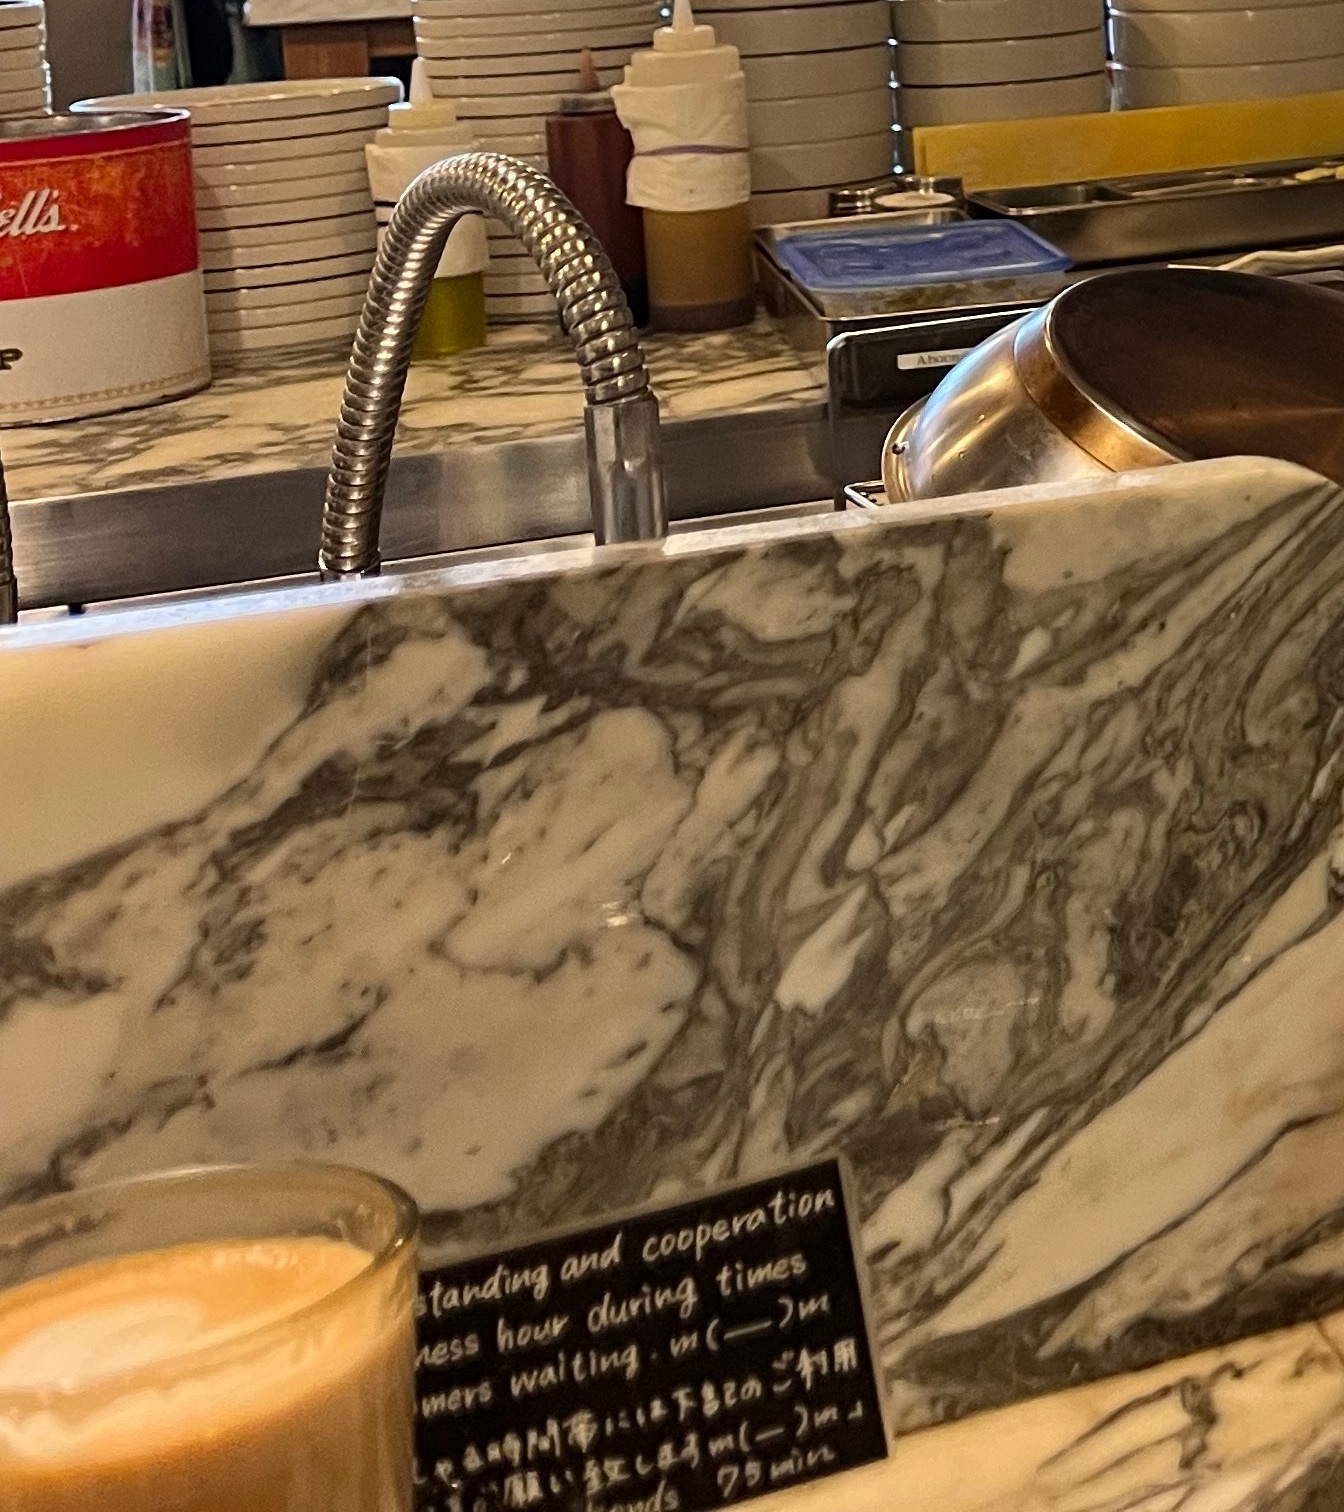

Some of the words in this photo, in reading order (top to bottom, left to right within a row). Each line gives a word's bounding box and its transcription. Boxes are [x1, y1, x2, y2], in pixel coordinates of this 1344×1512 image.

[560, 1230, 623, 1282] and
[642, 1188, 835, 1262] cooperation
[496, 1314, 570, 1354] hour
[587, 1276, 698, 1334] during
[715, 1252, 808, 1298] times
[412, 1380, 493, 1419] mers
